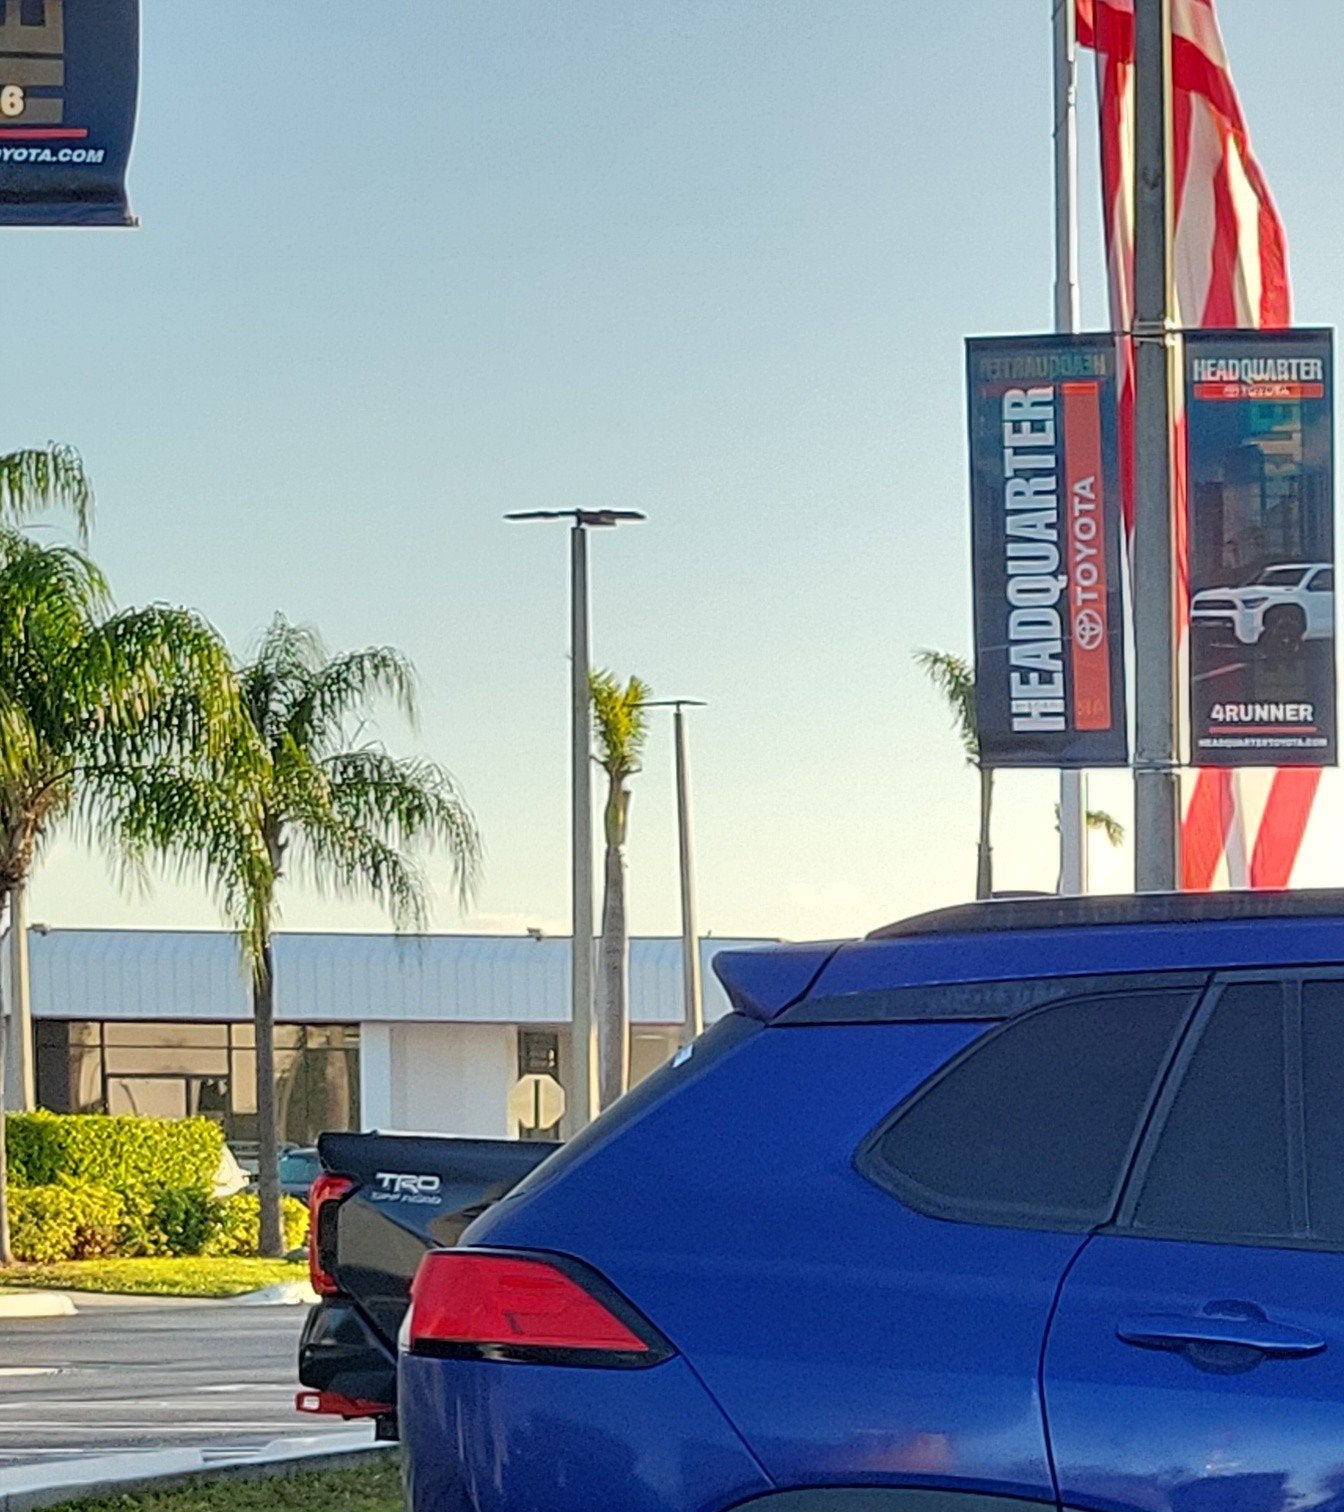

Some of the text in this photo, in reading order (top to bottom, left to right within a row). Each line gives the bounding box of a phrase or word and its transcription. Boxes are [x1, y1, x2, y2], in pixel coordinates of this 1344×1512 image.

[0, 148, 104, 163] YOTA.COM
[1193, 358, 1323, 384] HEADQUARTER
[1072, 476, 1098, 606] TOYOTA
[1003, 387, 1066, 732] HEADQUARTER
[1210, 703, 1314, 722] 4RUNNER
